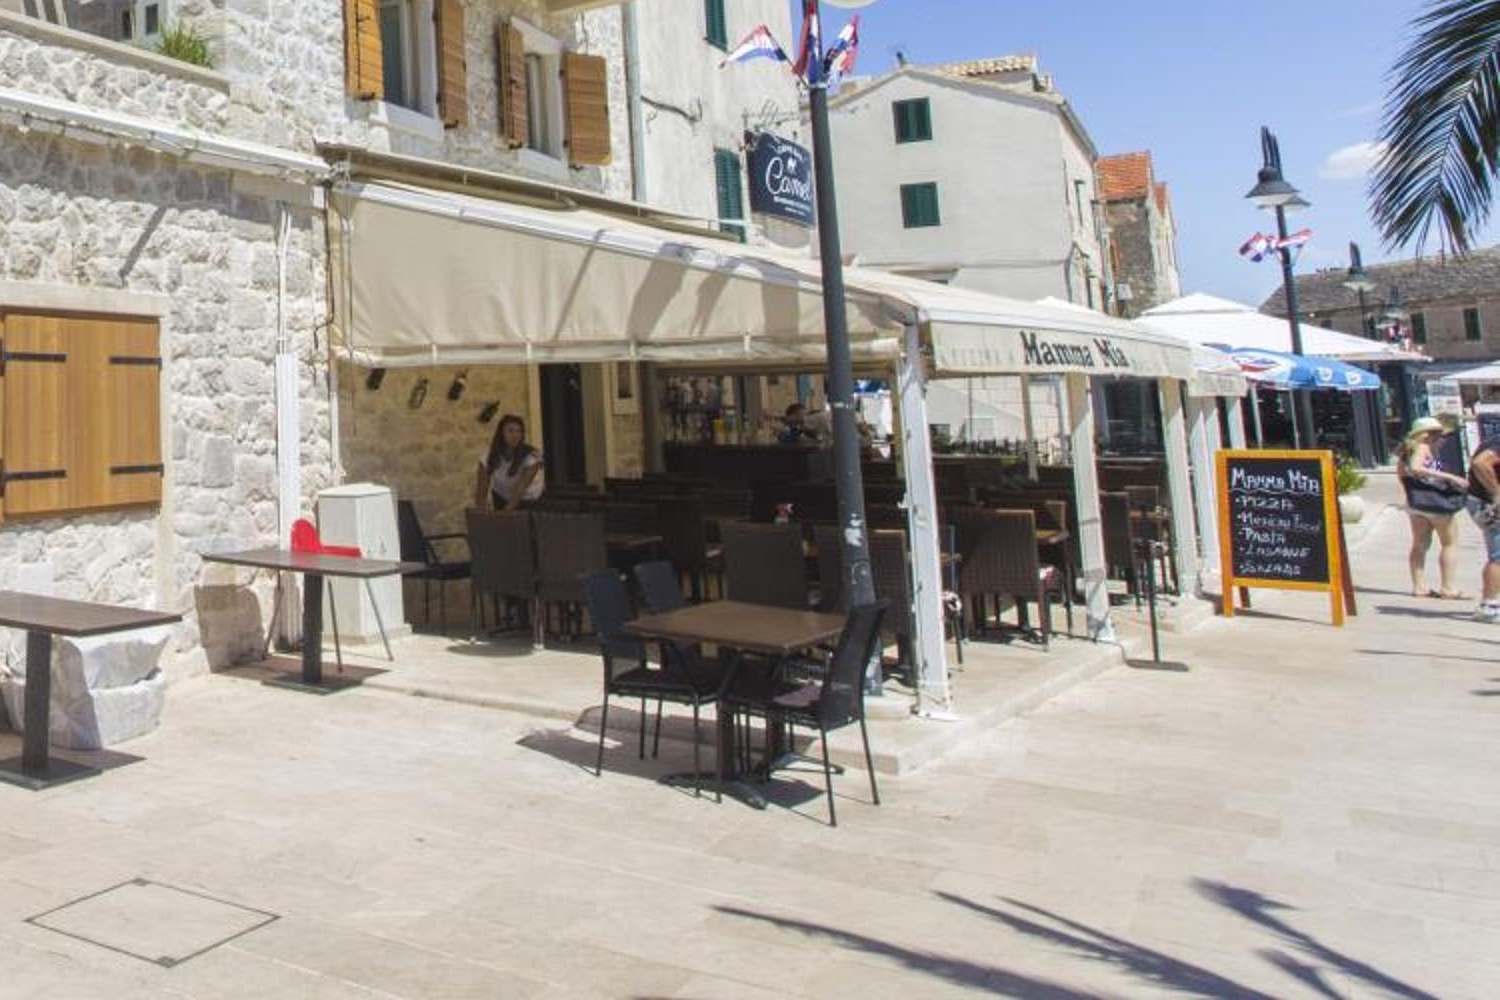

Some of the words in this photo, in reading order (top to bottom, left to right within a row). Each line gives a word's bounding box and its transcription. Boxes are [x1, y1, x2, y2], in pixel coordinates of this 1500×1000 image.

[765, 156, 812, 201] Camel
[1020, 331, 1095, 367] Mamma
[1093, 337, 1129, 367] Mia
